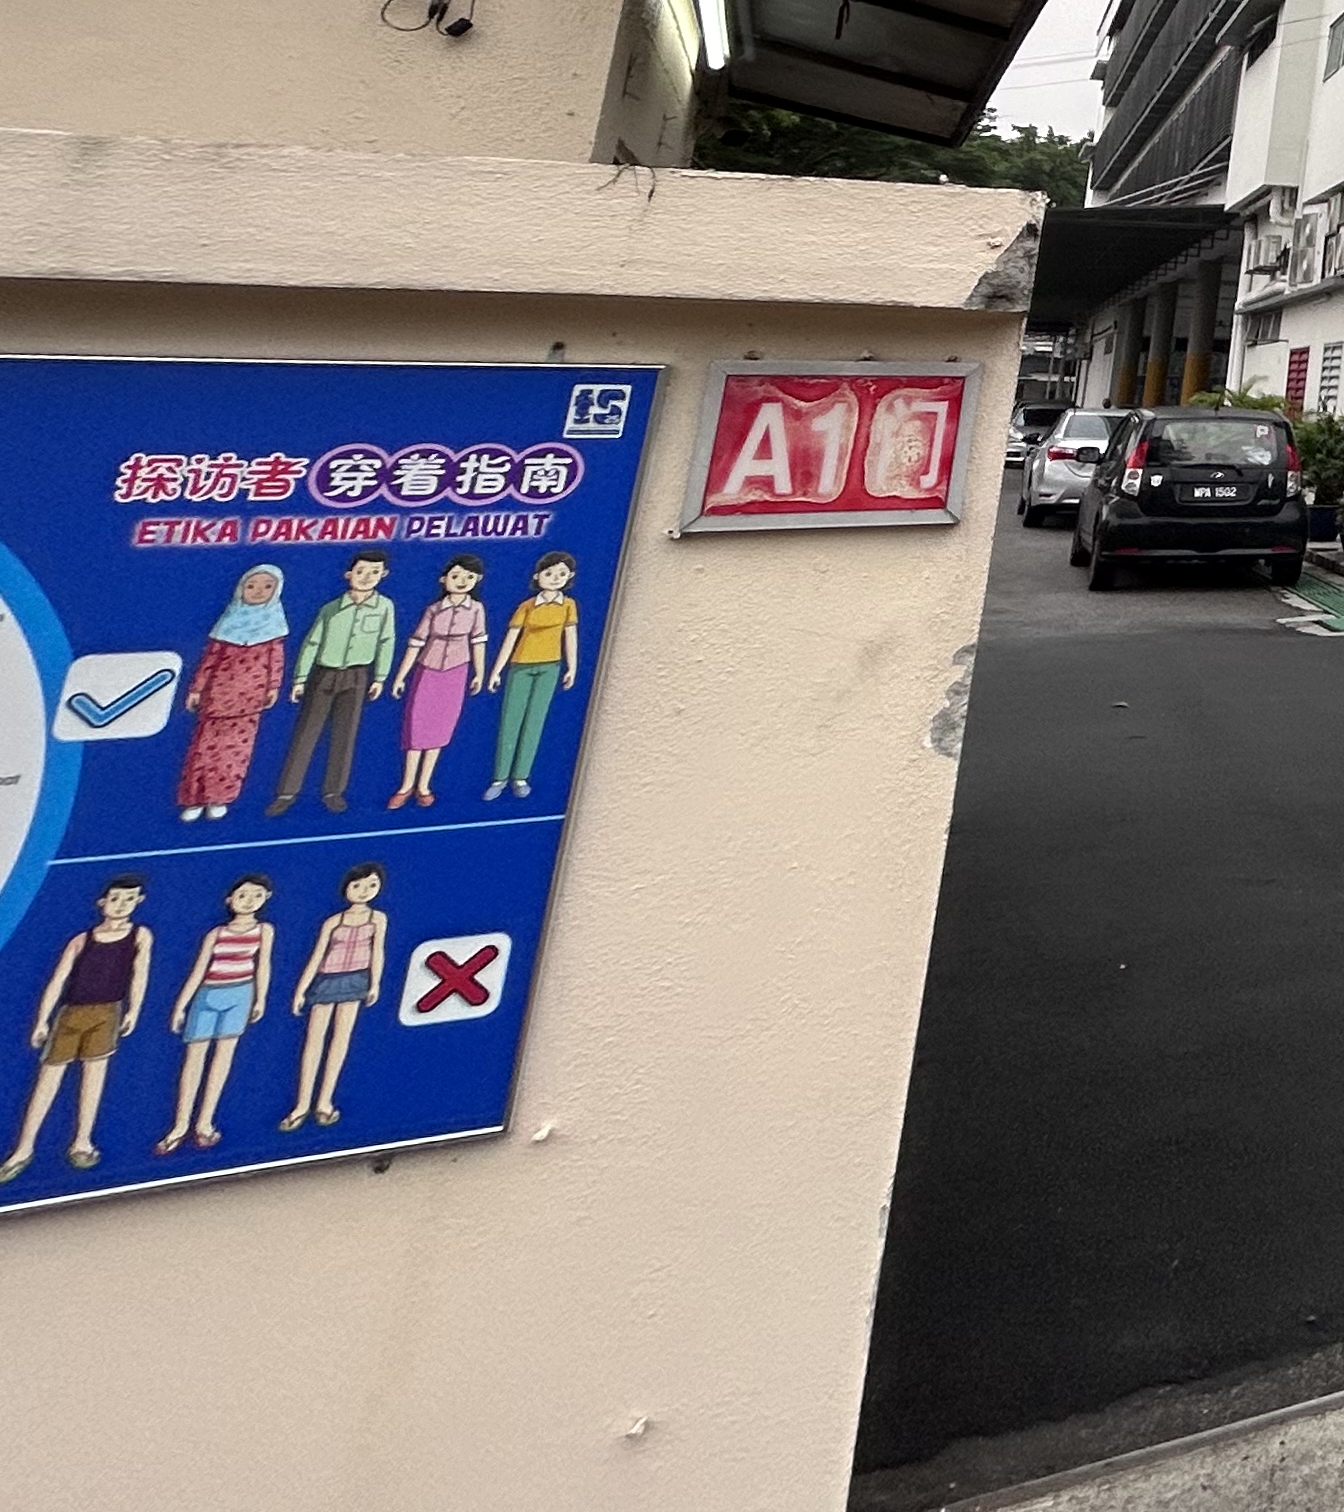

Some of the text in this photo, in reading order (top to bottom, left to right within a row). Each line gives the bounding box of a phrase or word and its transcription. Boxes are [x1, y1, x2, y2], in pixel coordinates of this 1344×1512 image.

[134, 510, 551, 547] ETIKA PAKAIAN PELAWAT
